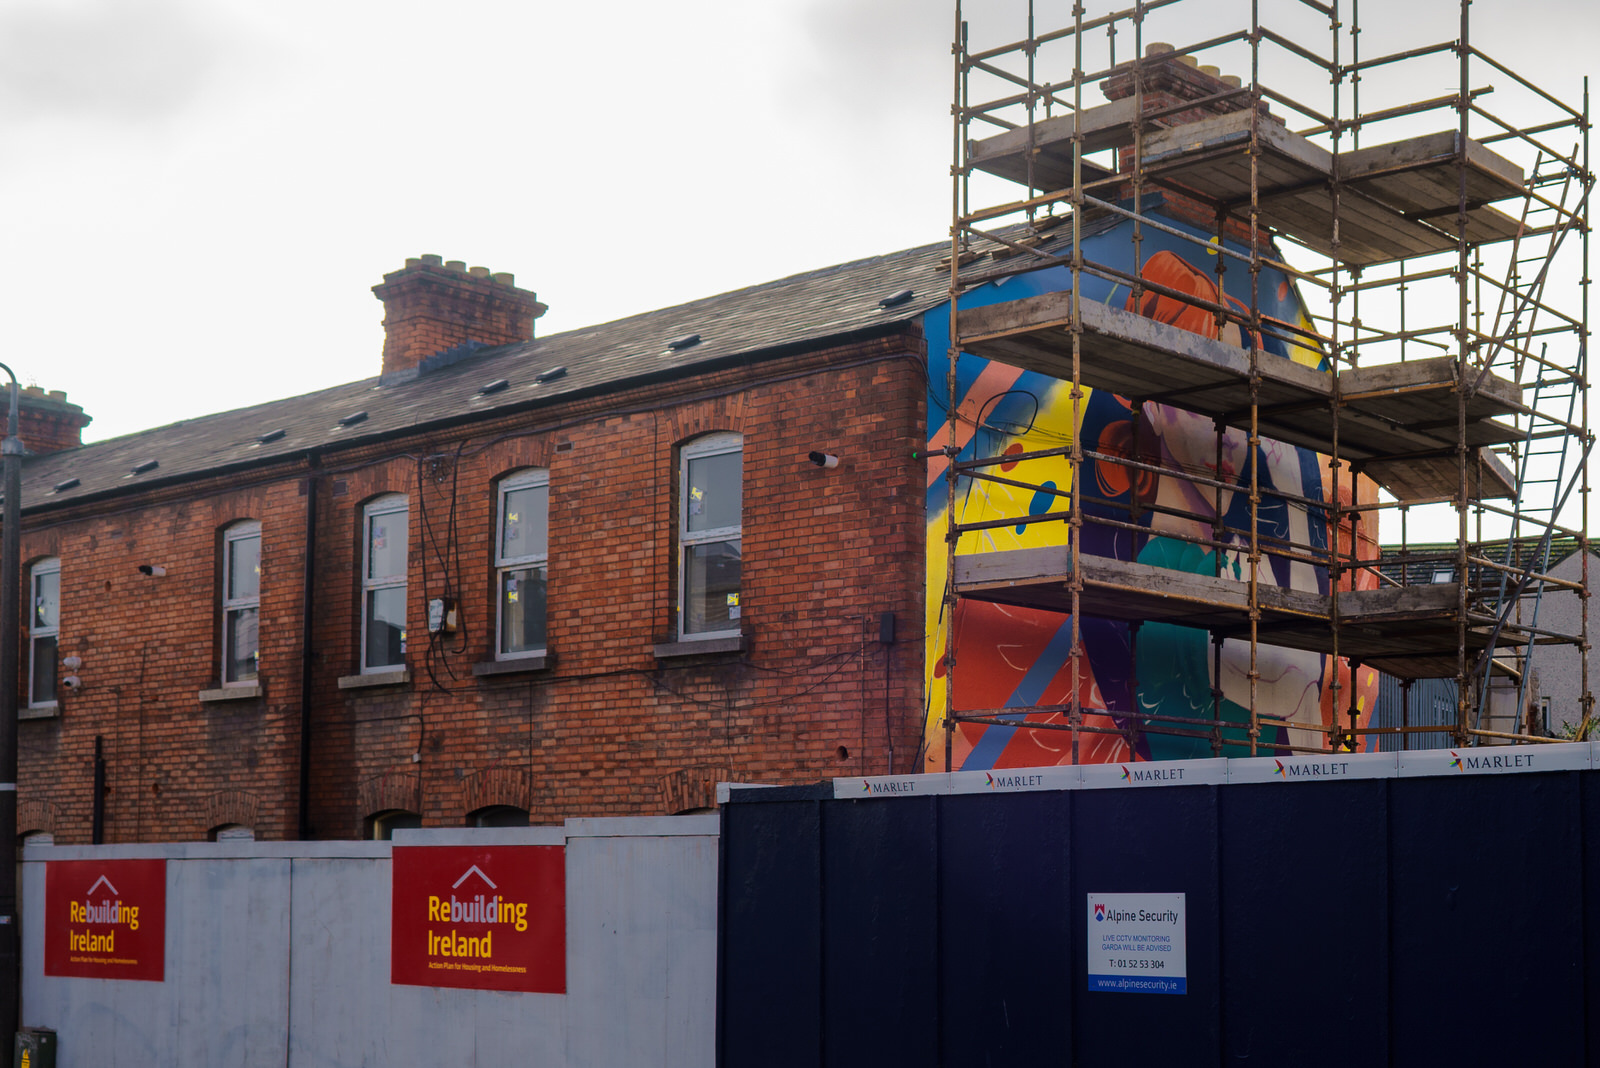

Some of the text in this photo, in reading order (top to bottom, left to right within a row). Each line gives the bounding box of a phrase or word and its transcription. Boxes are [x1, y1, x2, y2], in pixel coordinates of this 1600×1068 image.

[1467, 754, 1534, 769] MARLET
[1133, 768, 1185, 781] MARLET
[1289, 762, 1349, 776] MARLET
[873, 781, 916, 793] MARLET
[996, 775, 1043, 787] MARLET
[70, 900, 139, 930] Rebuilding
[428, 895, 528, 932] Rebuilding
[1106, 909, 1179, 925] Alpine Security
[70, 929, 114, 952] Ireland
[428, 929, 492, 958] Ireland
[1102, 934, 1171, 943] LIVE CCTV MONITORING
[1101, 943, 1123, 951] GARDA
[1136, 944, 1145, 952] BE
[1145, 944, 1172, 952] ADVISED
[1109, 959, 1165, 969] T: 01 52 53 304
[1097, 978, 1177, 991] www.alpinesecurity.ie
